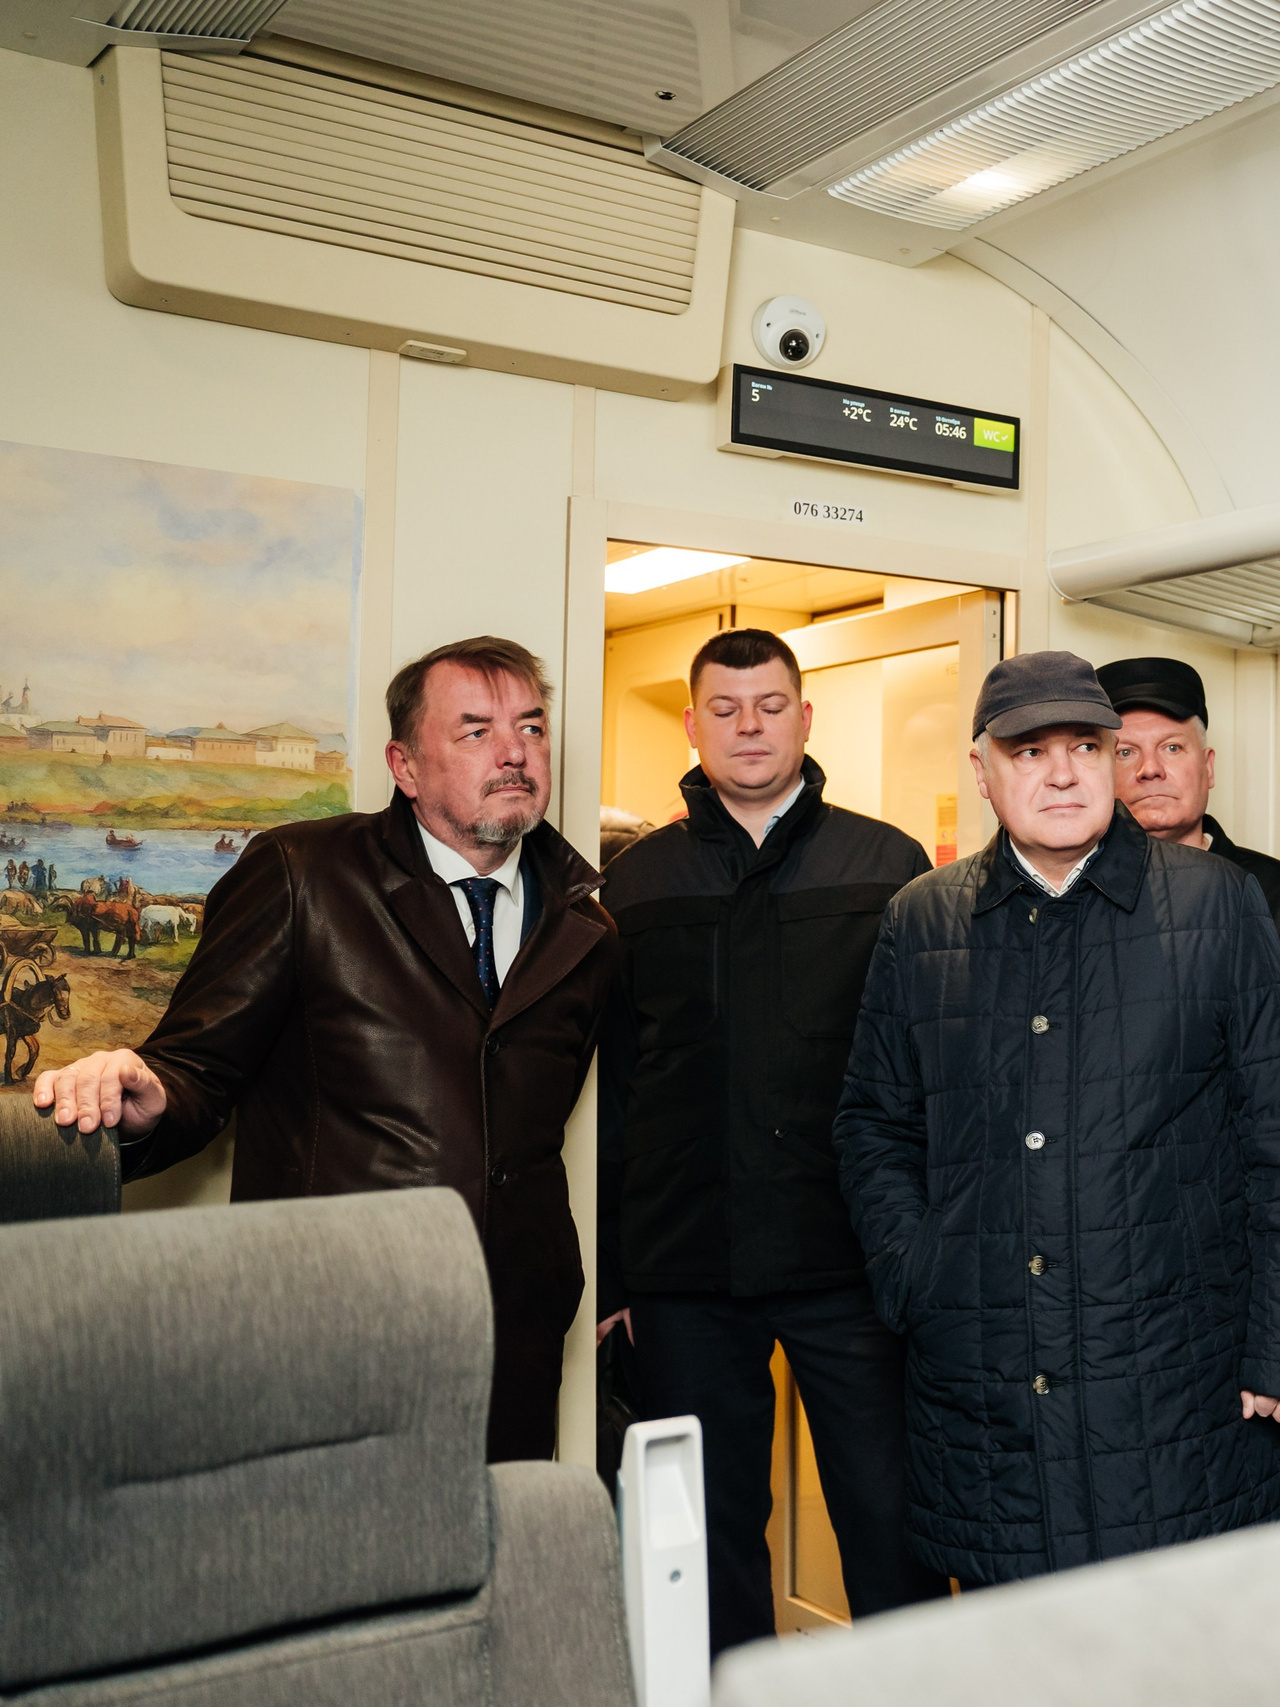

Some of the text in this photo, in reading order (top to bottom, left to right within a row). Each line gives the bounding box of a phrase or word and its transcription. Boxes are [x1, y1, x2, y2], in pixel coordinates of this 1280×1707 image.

[751, 388, 760, 402] 5
[935, 422, 967, 439] 05:46
[983, 429, 1000, 443] WC
[793, 501, 864, 523] 076 33274
